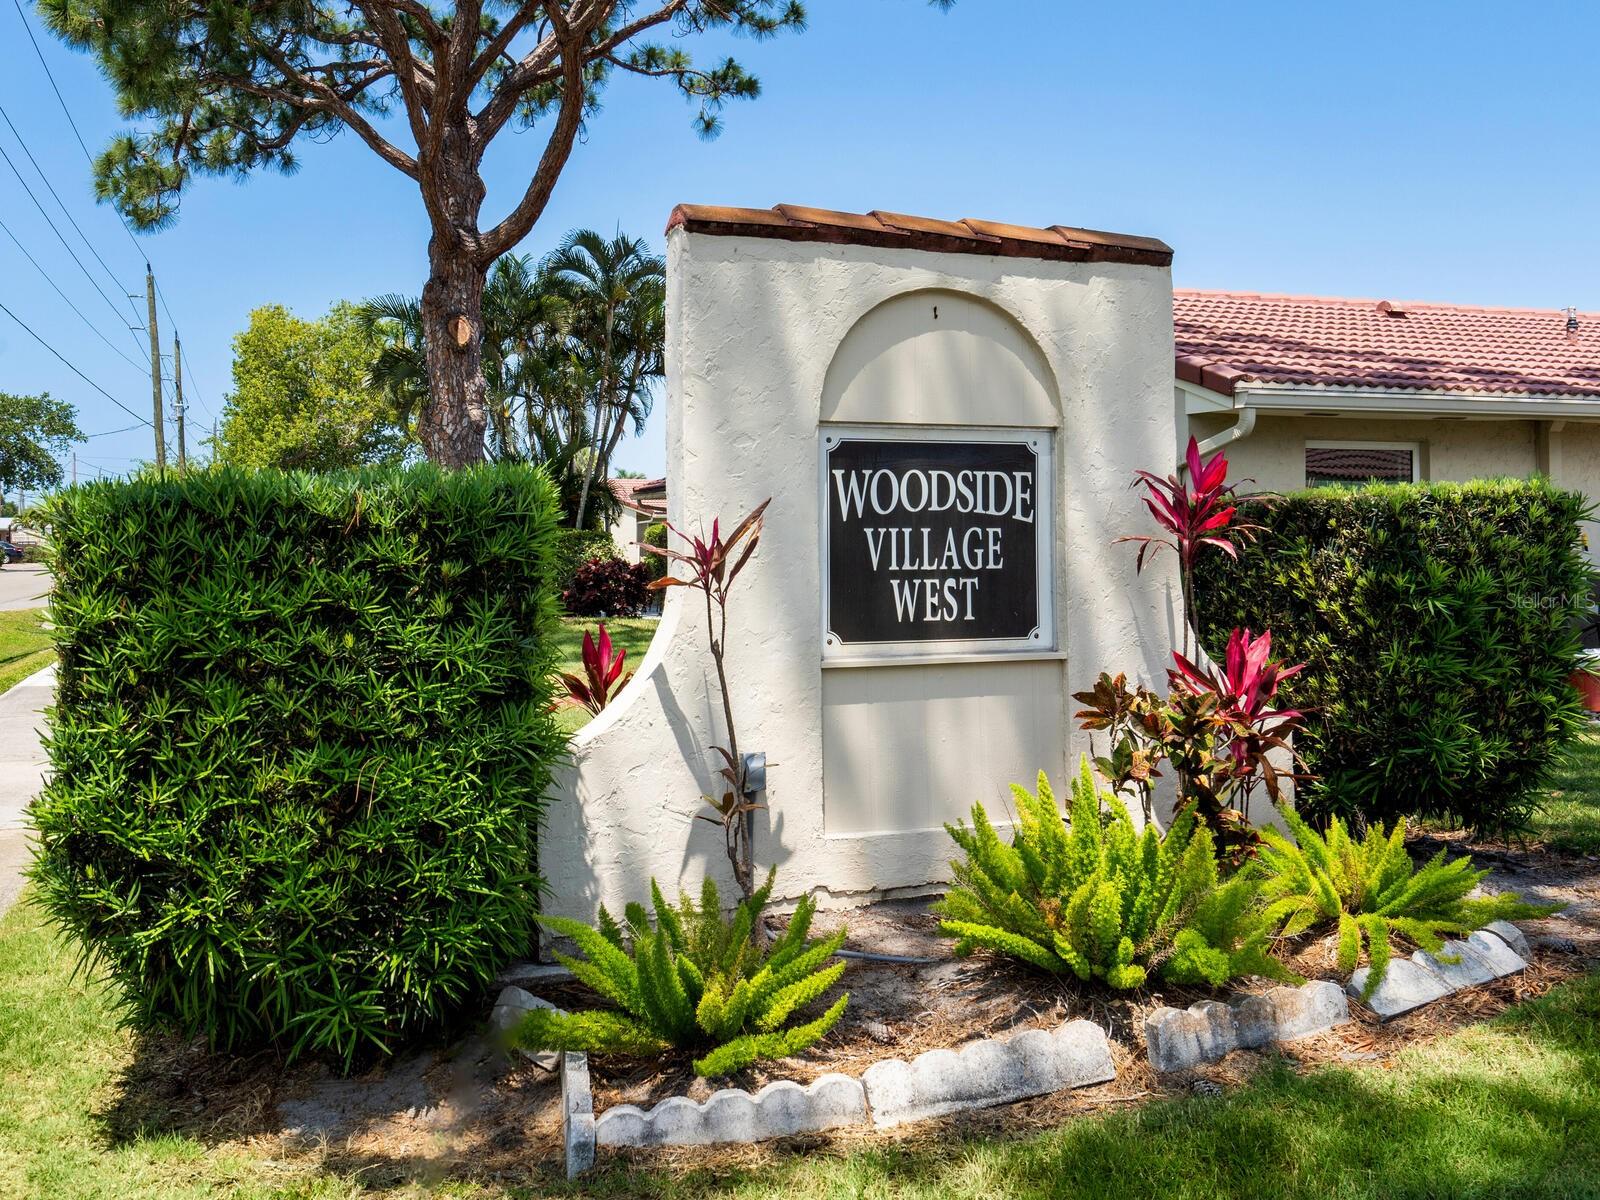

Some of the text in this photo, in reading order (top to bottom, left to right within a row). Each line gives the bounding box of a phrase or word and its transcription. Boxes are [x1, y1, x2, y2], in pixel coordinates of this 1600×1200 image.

[832, 468, 1034, 523] WOODSIDE
[863, 527, 1004, 571] VILLAGE
[890, 577, 979, 622] WEST
